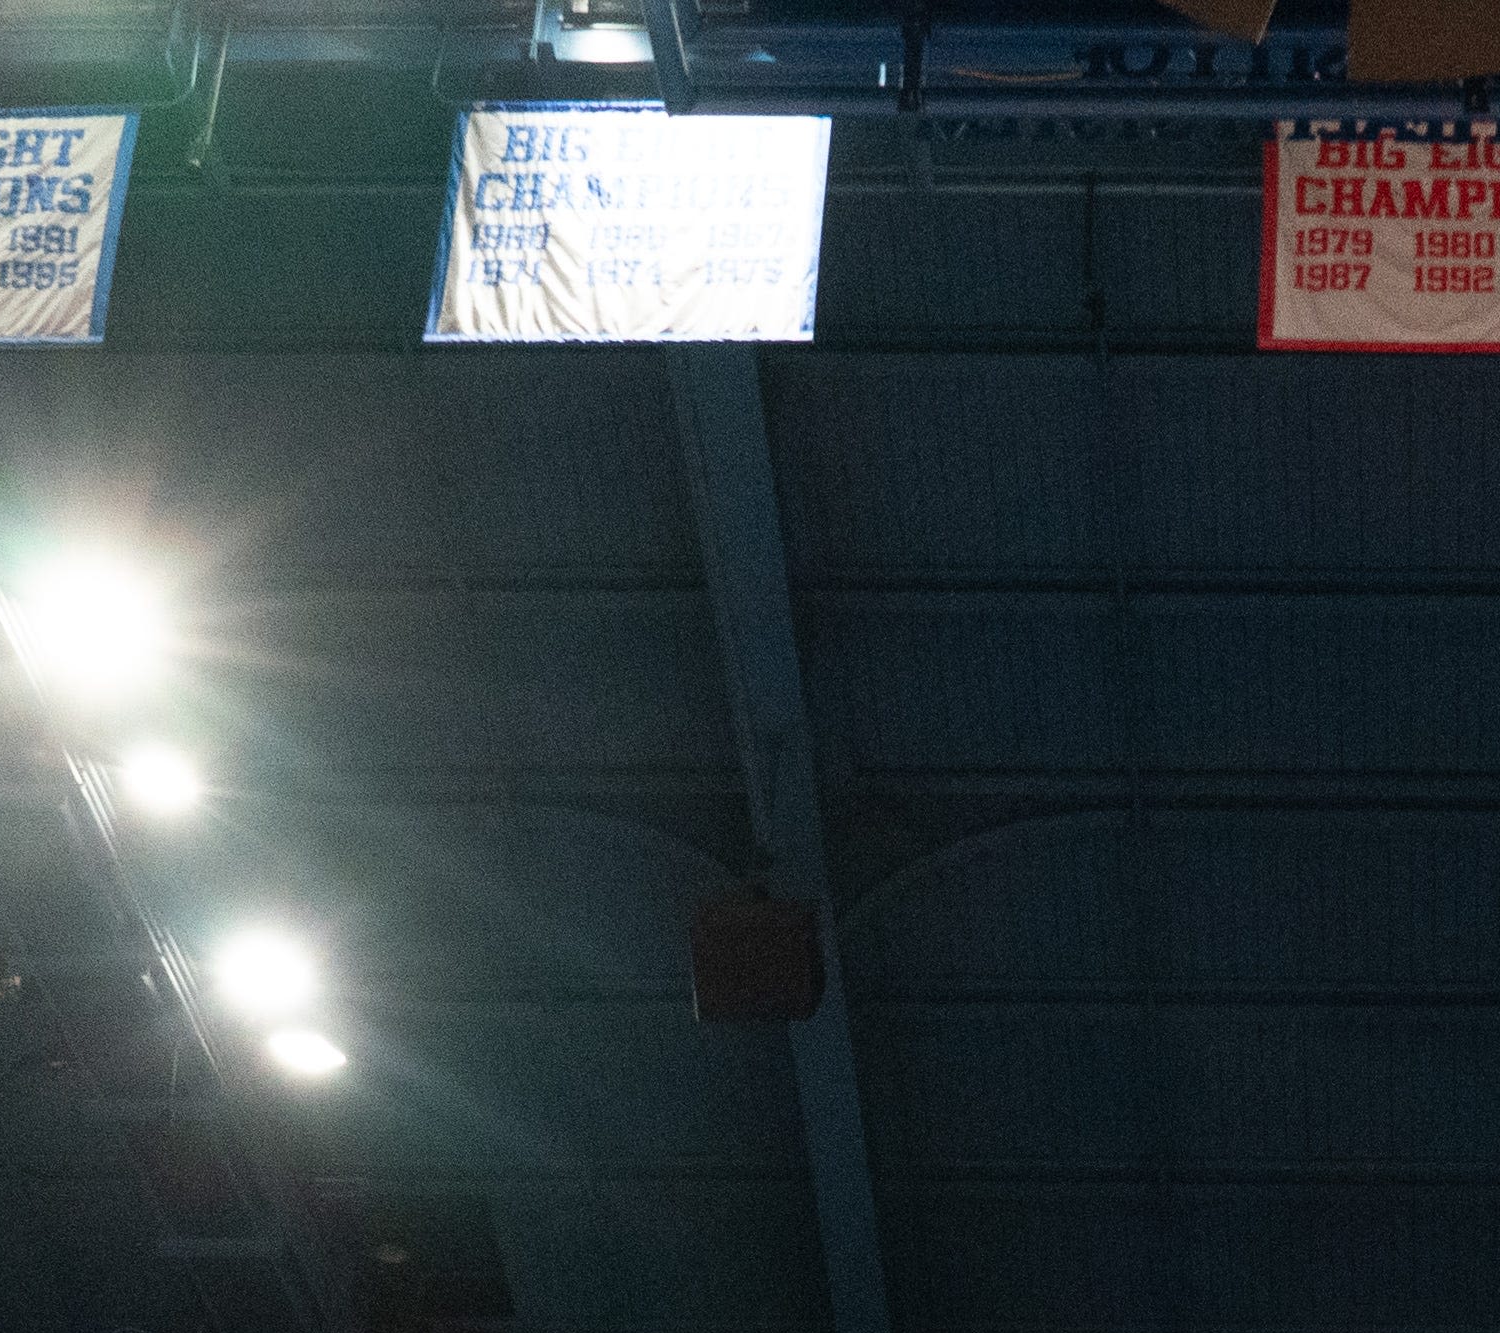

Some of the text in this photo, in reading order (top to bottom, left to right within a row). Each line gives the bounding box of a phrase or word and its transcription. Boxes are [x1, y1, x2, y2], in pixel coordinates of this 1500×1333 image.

[499, 124, 592, 164] BIG
[1314, 133, 1407, 171] BIG
[473, 172, 792, 213] CHAMPIONS
[1294, 228, 1374, 258] 1979
[1413, 228, 1496, 260] 1980
[1293, 261, 1373, 292] 1987
[1413, 262, 1496, 294] 1992
